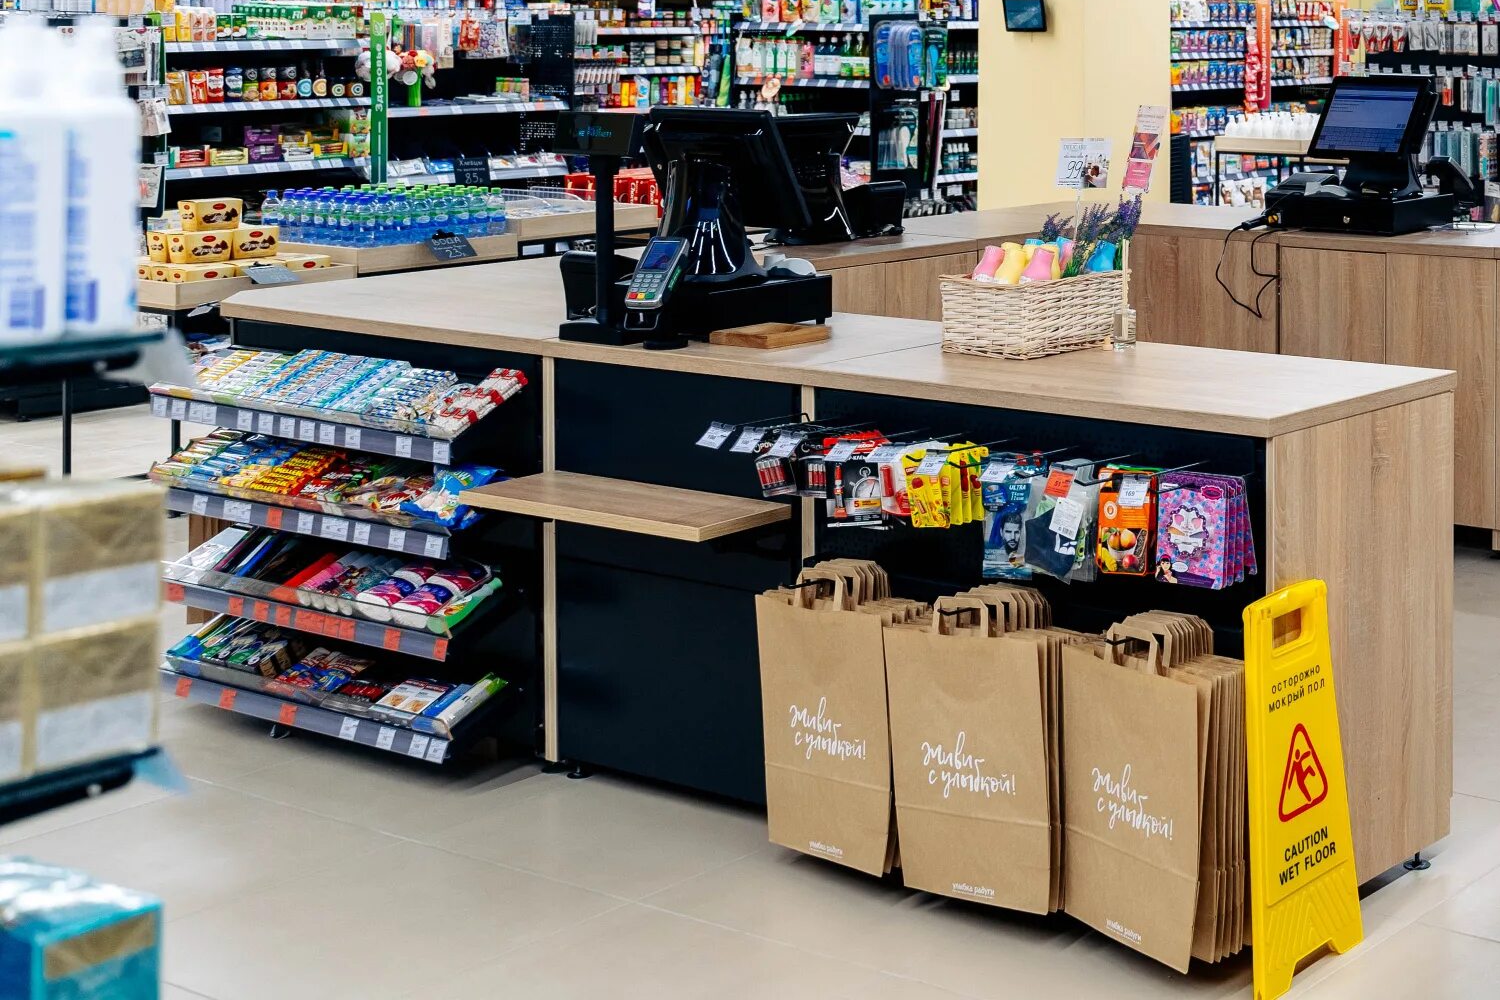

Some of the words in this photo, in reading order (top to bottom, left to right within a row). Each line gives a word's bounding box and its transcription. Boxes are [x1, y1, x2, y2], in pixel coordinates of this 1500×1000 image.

[375, 43, 384, 112] Здоровье
[1279, 862, 1301, 887] WET
[1304, 842, 1337, 874] FLOOR
[1284, 826, 1329, 863] CAUTION
